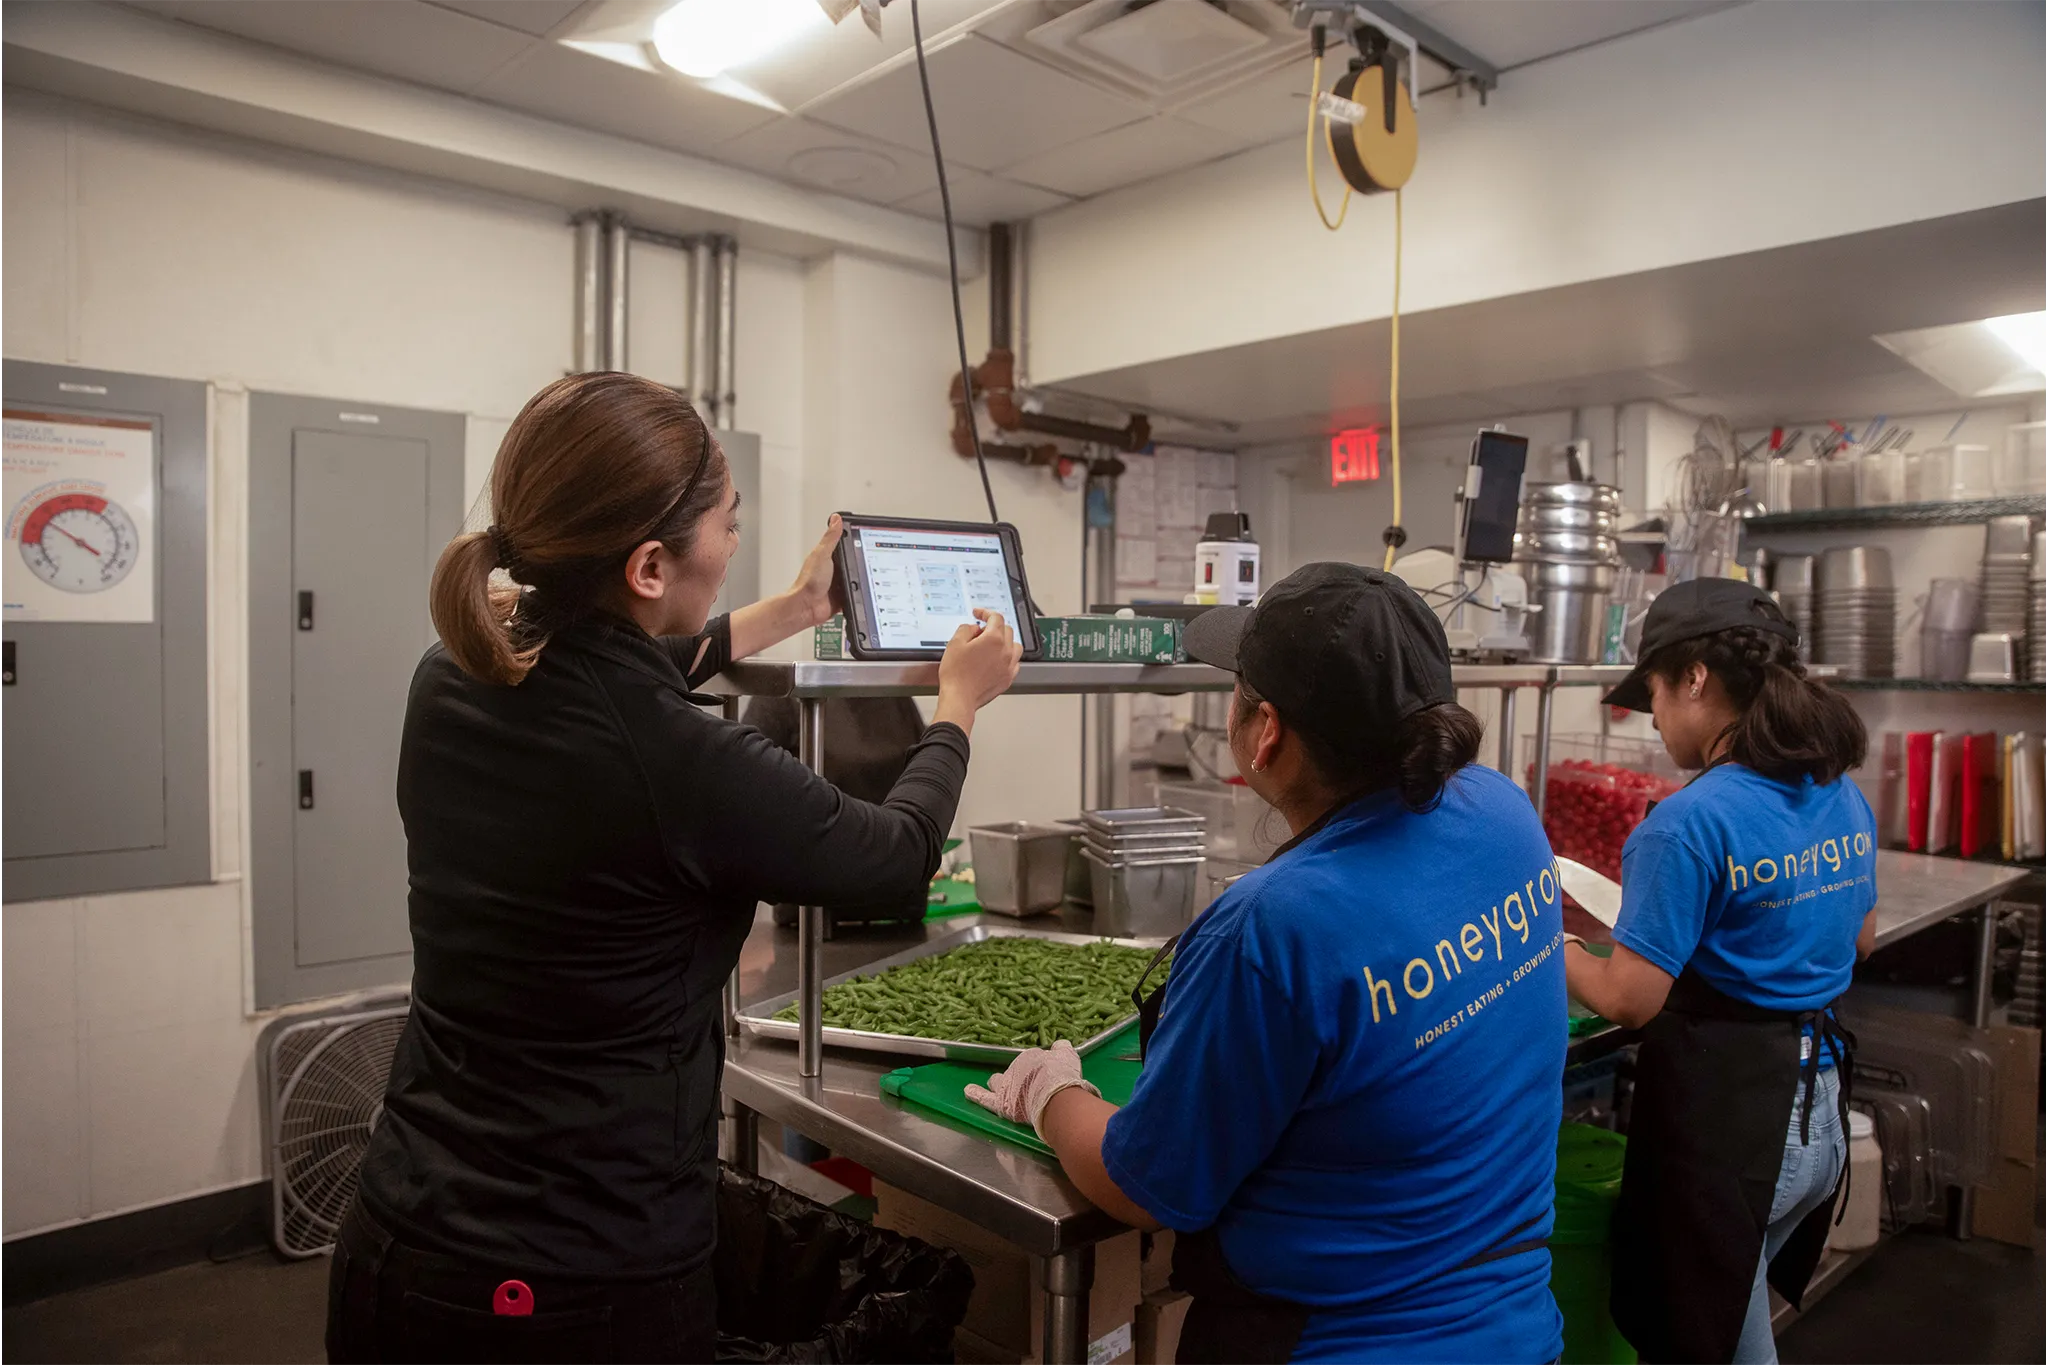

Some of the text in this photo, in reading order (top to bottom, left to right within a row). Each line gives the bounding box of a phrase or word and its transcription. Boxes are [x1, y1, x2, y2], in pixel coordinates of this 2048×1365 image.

[1332, 434, 1380, 482] EXIT
[1061, 620, 1069, 638] Vinyl
[1415, 1010, 1465, 1049] HONEST
[1466, 983, 1504, 1017] EATING
[1505, 979, 1511, 988] +
[1513, 944, 1551, 982] GROWING
